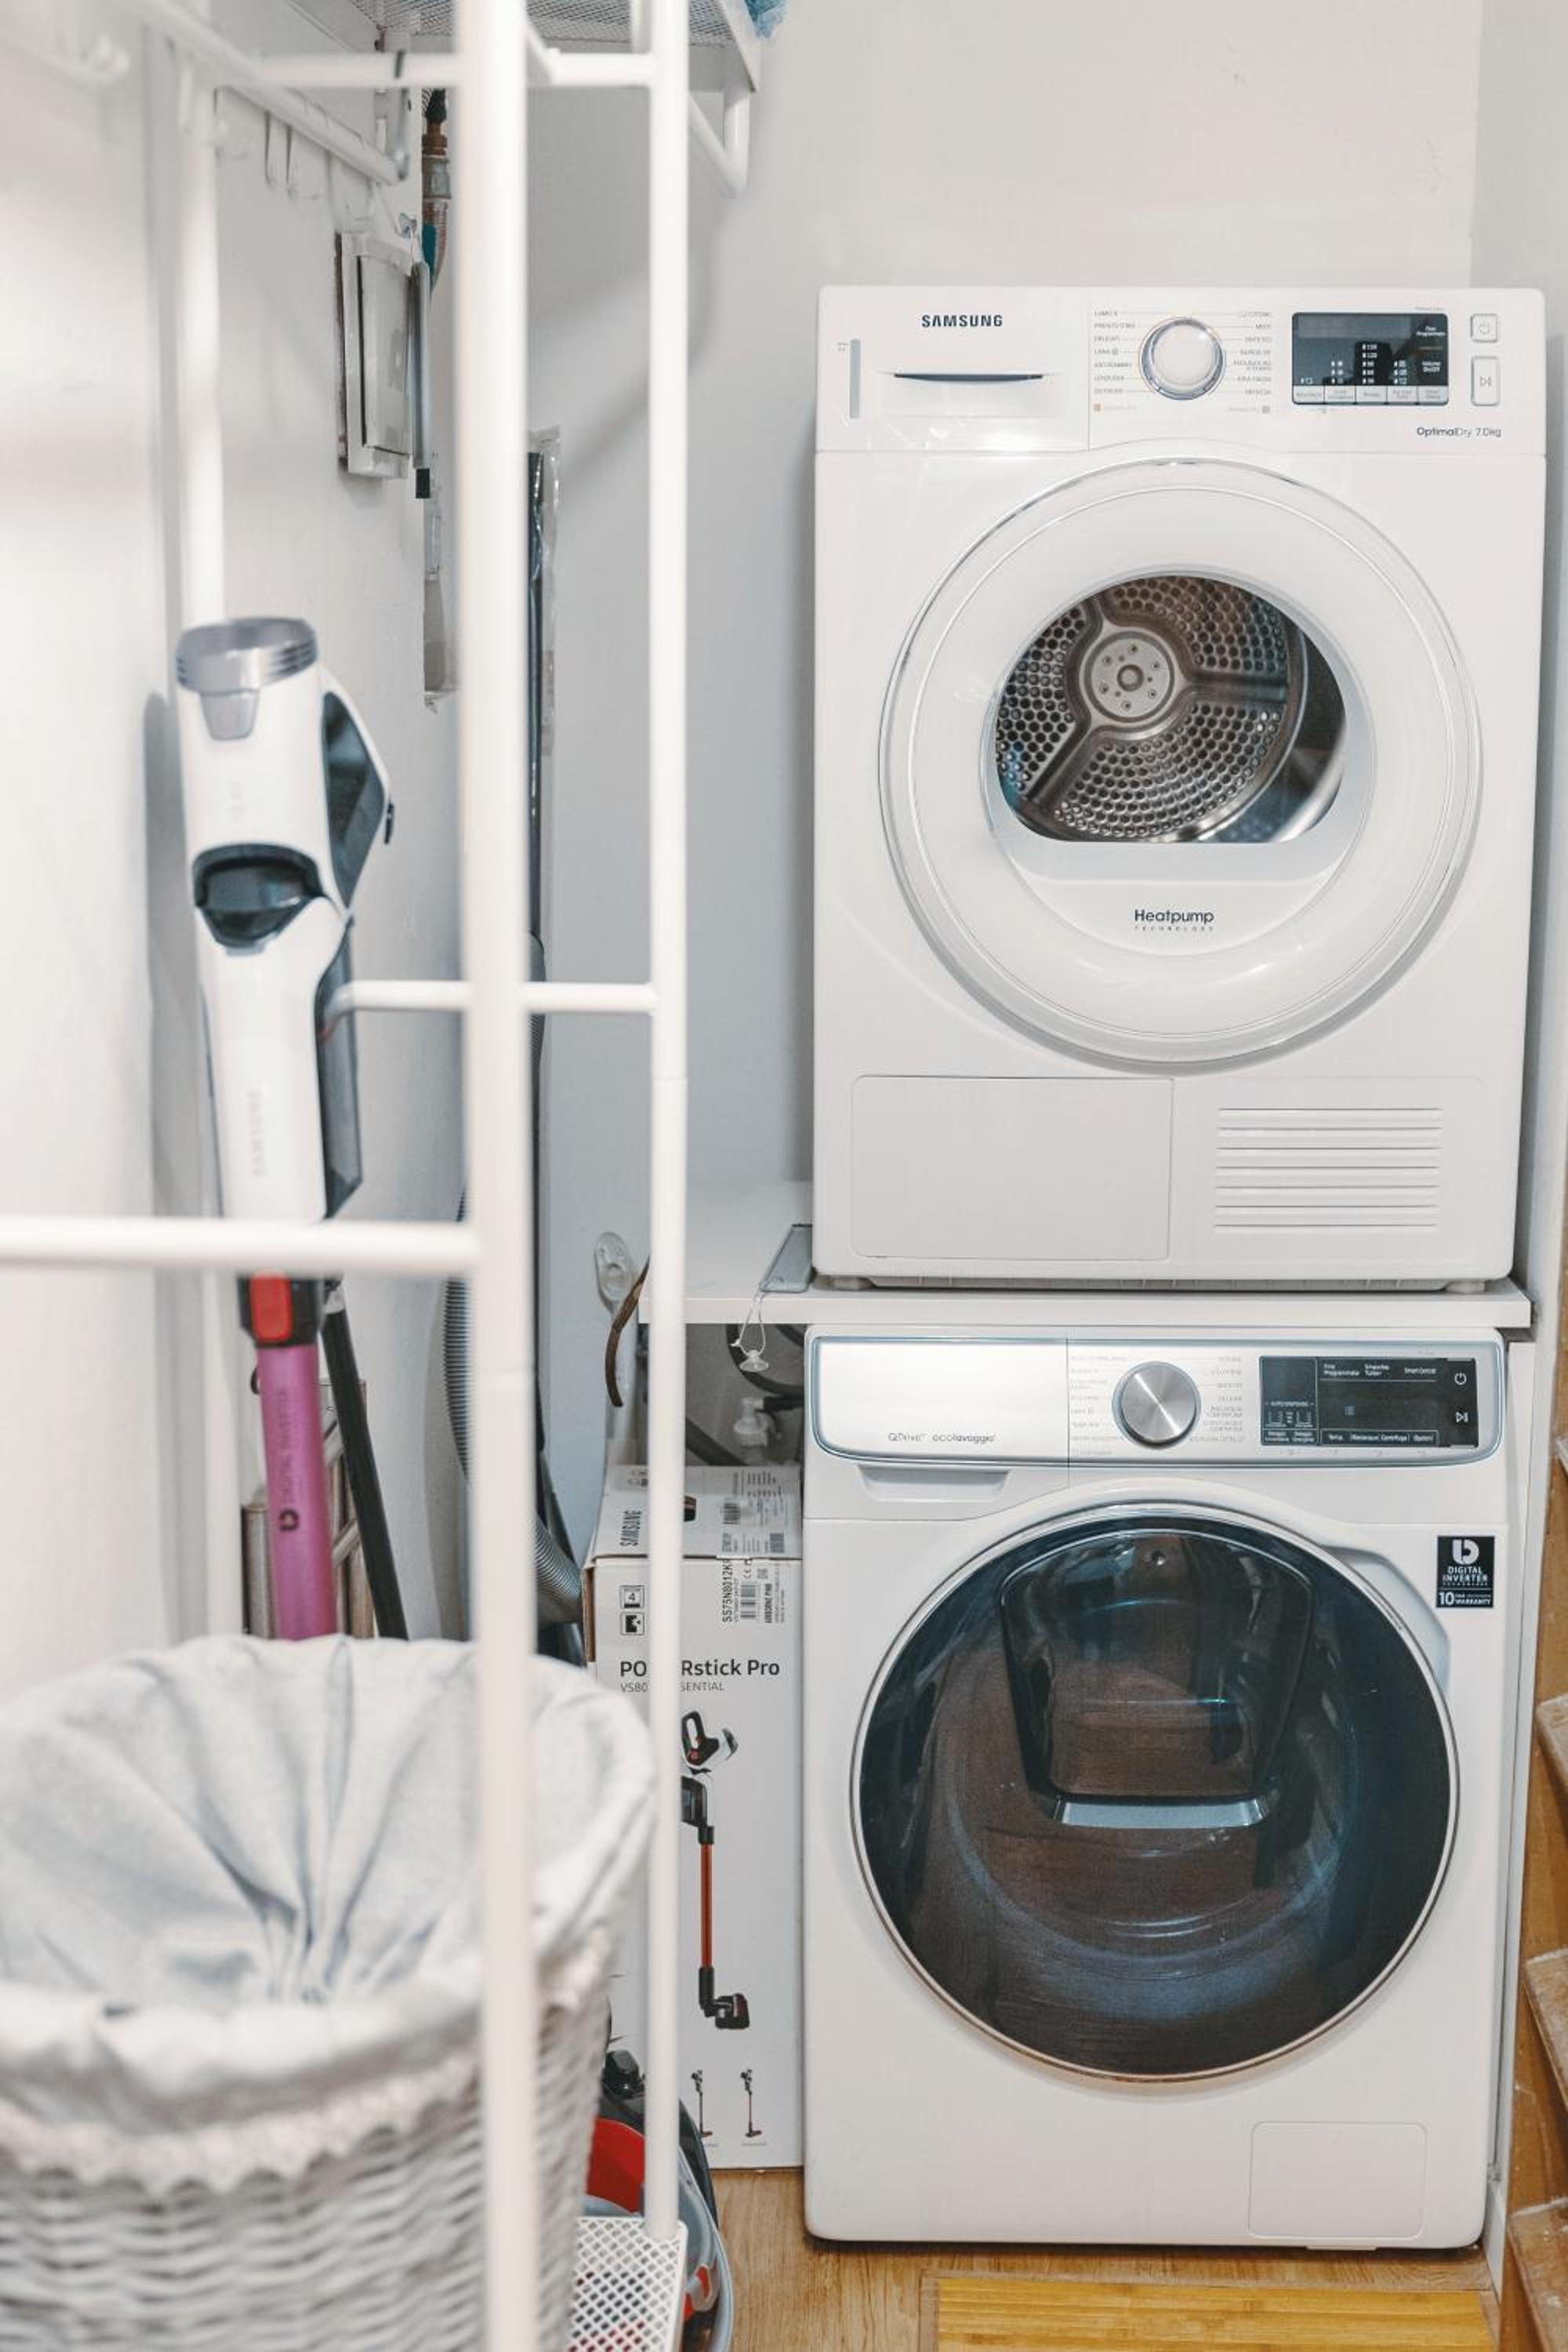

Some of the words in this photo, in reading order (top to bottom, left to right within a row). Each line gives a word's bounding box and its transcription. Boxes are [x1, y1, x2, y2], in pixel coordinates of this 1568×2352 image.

[921, 315, 1003, 328] SAMSUNG
[1417, 426, 1472, 438] OptimalDry
[1134, 909, 1214, 924] Heatpump
[1443, 1573, 1488, 1582] INVERTER
[1439, 1592, 1454, 1606] 10
[620, 1659, 742, 1677] PORstick
[747, 1660, 781, 1676] Pro
